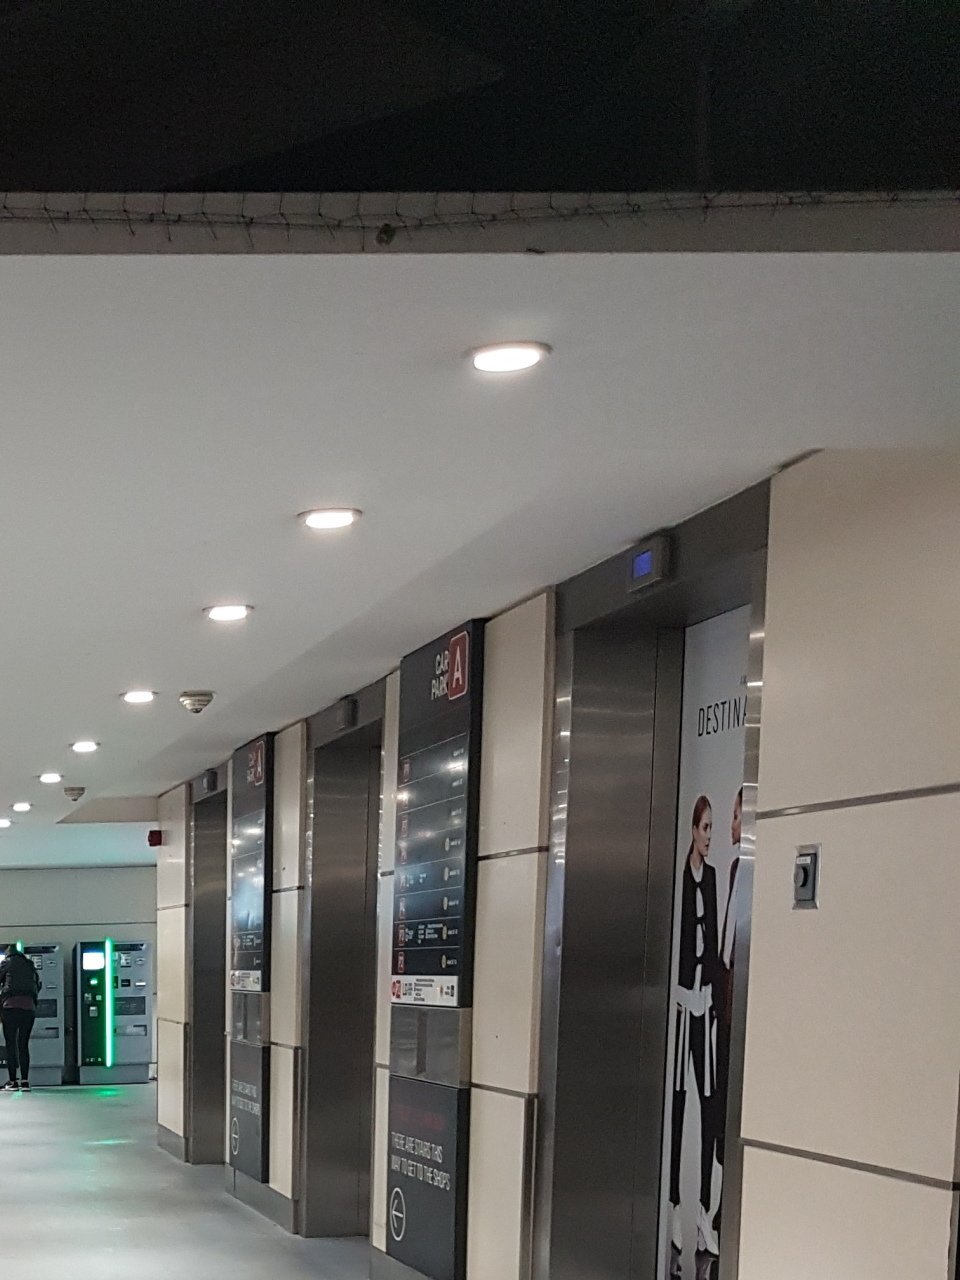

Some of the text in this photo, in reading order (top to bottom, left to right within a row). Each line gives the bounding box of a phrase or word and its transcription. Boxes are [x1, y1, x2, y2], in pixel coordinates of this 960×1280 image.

[435, 650, 449, 675] CAR
[452, 645, 463, 688] A
[431, 672, 449, 700] PARK
